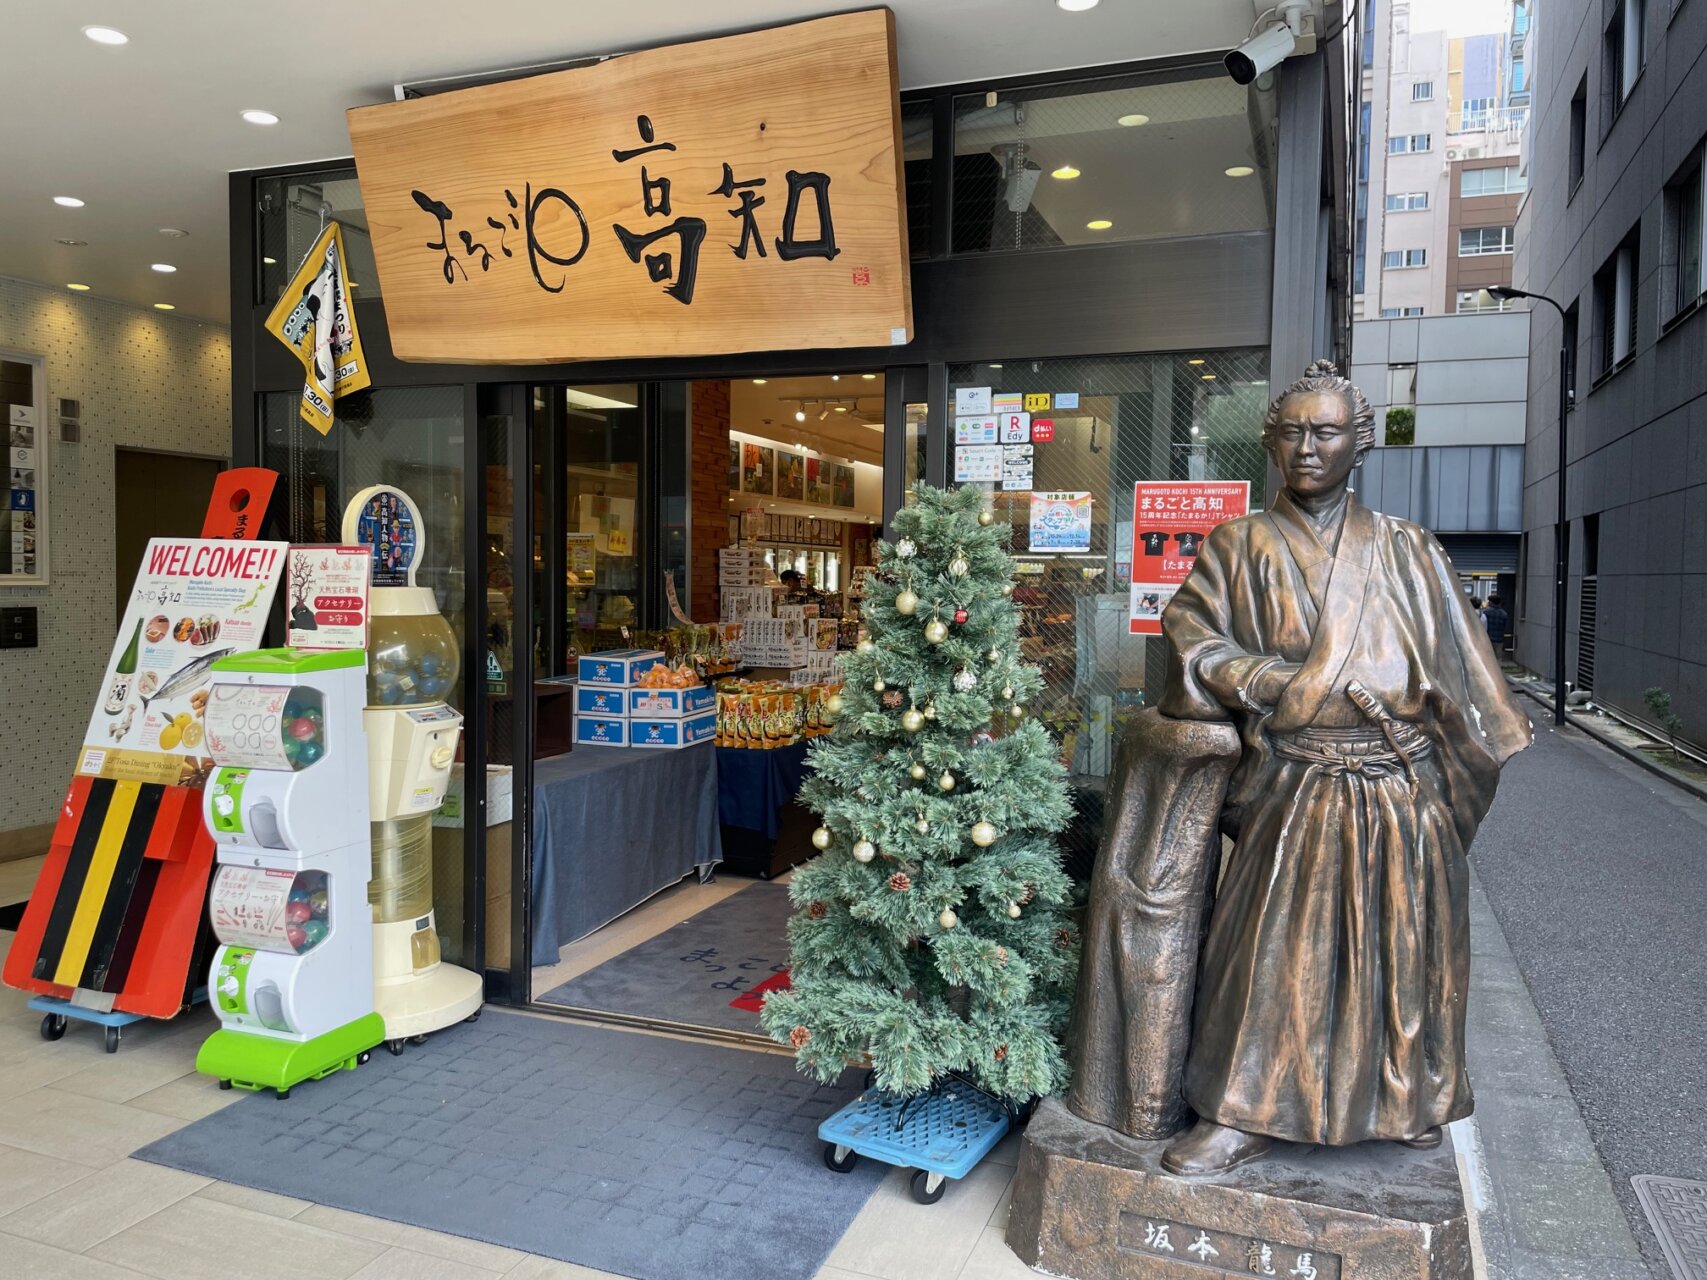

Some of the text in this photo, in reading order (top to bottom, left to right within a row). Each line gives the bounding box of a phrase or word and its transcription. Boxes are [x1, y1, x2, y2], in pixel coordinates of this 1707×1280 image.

[1007, 432, 1023, 441] Edy
[1141, 497, 1224, 511] まるごと高知
[147, 544, 278, 580] WELCOME!!
[317, 599, 361, 608] アクセサリー
[328, 613, 349, 624] お守り
[109, 684, 127, 702] 酒
[1144, 1221, 1318, 1280] 坂本龍馬
